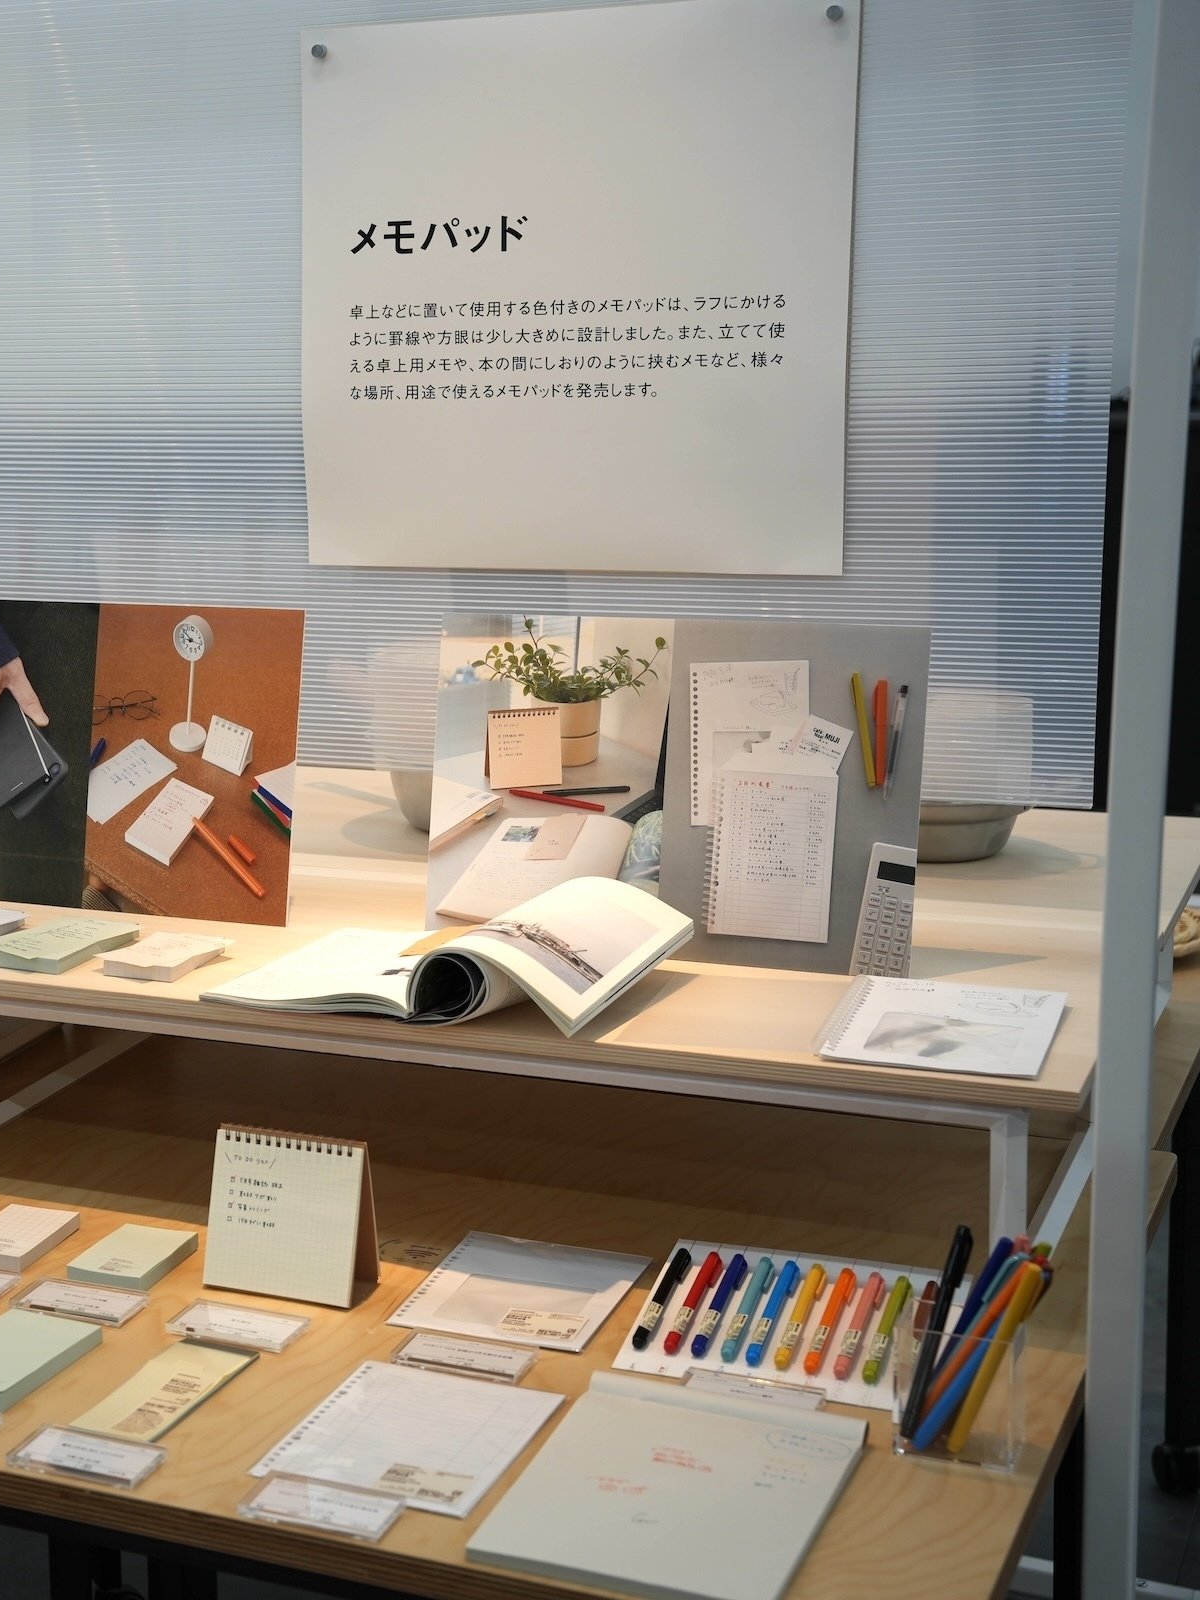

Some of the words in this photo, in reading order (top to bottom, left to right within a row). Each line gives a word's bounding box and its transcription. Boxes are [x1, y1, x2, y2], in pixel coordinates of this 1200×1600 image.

[349, 215, 529, 255] メモパッド
[349, 293, 786, 321] 卓上などに置いて使用する色付きのメモパッドは、ラフにかける
[349, 321, 786, 347] ように罫線や方眼は少し大きめに設計しました。また、立てて使
[349, 350, 785, 374] える卓上用メモや、本の間にしおりのように挟むメモなど、様々
[349, 381, 658, 401] な場所、用途で使えるメモパッドを発売します。
